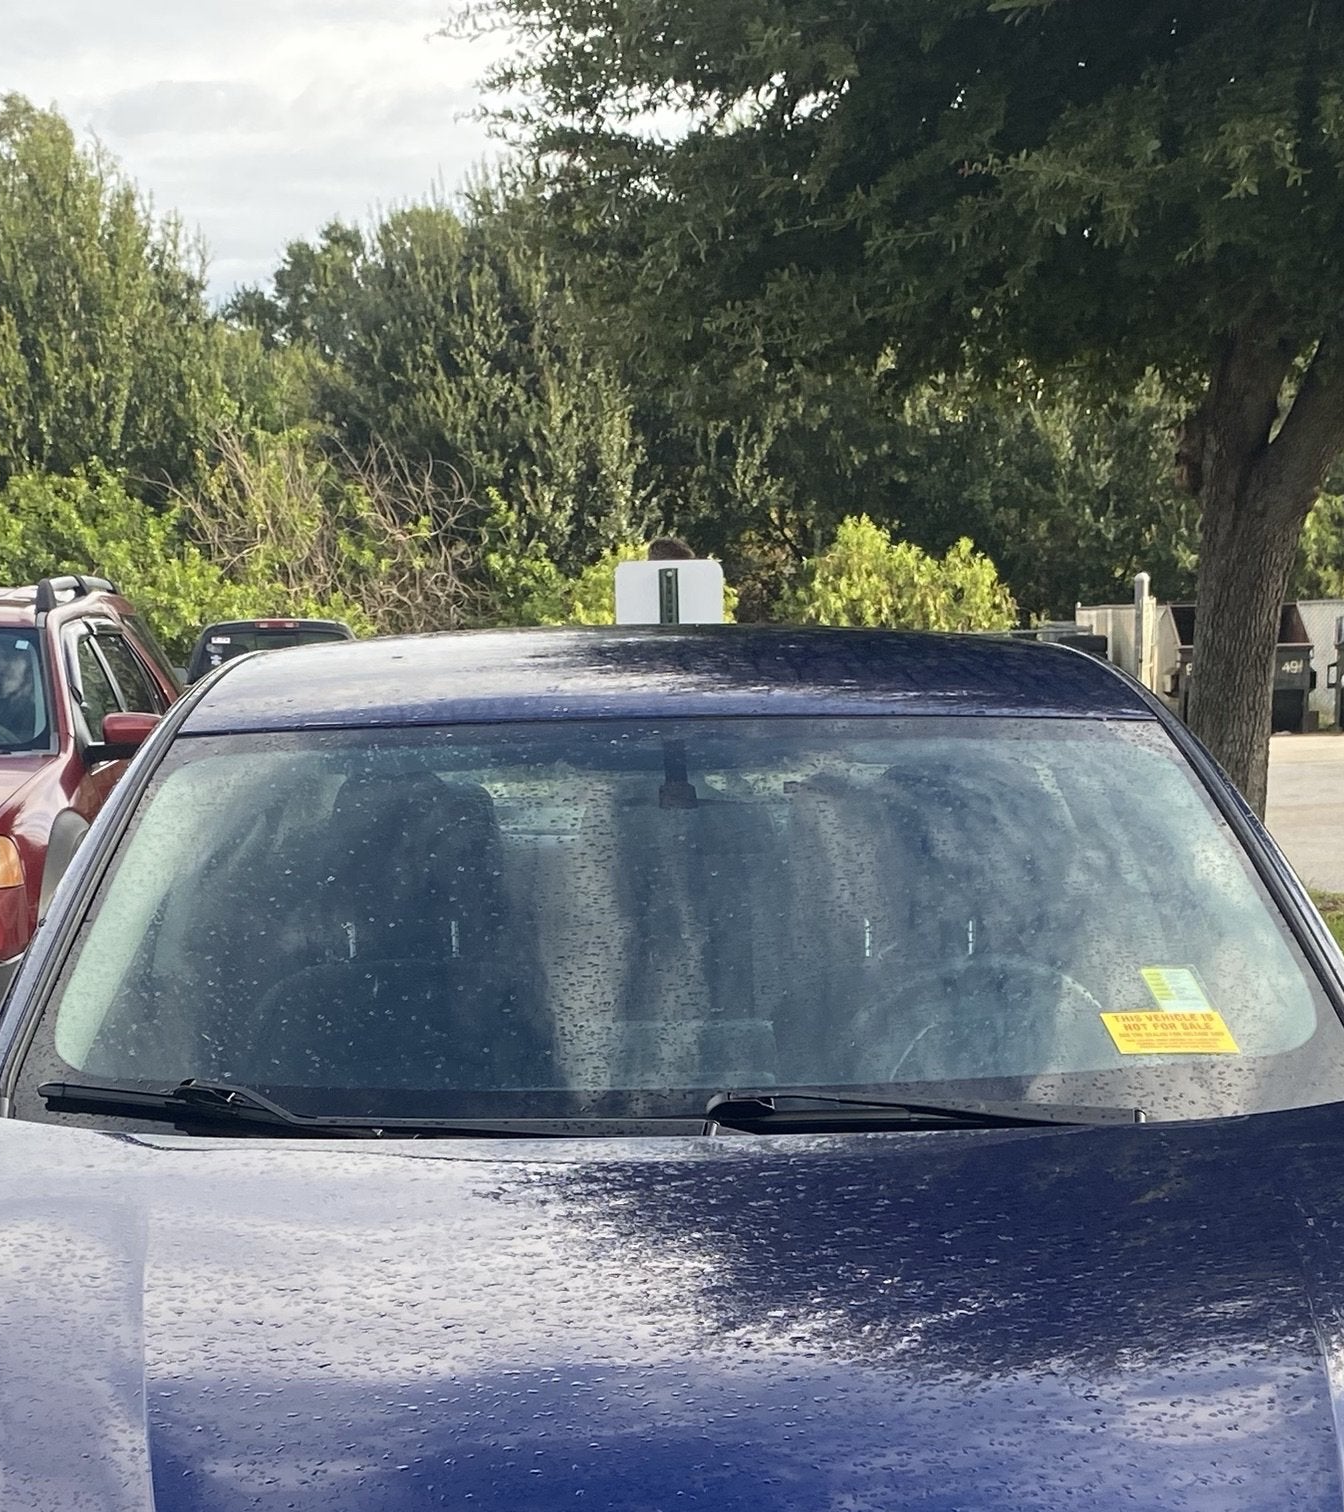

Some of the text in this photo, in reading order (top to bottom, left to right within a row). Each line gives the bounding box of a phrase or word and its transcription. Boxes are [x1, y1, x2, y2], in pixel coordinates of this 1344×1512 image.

[1112, 1013, 1214, 1023] THIS VEHICLE IS
[1123, 1022, 1214, 1031] NOT FOR SALE
